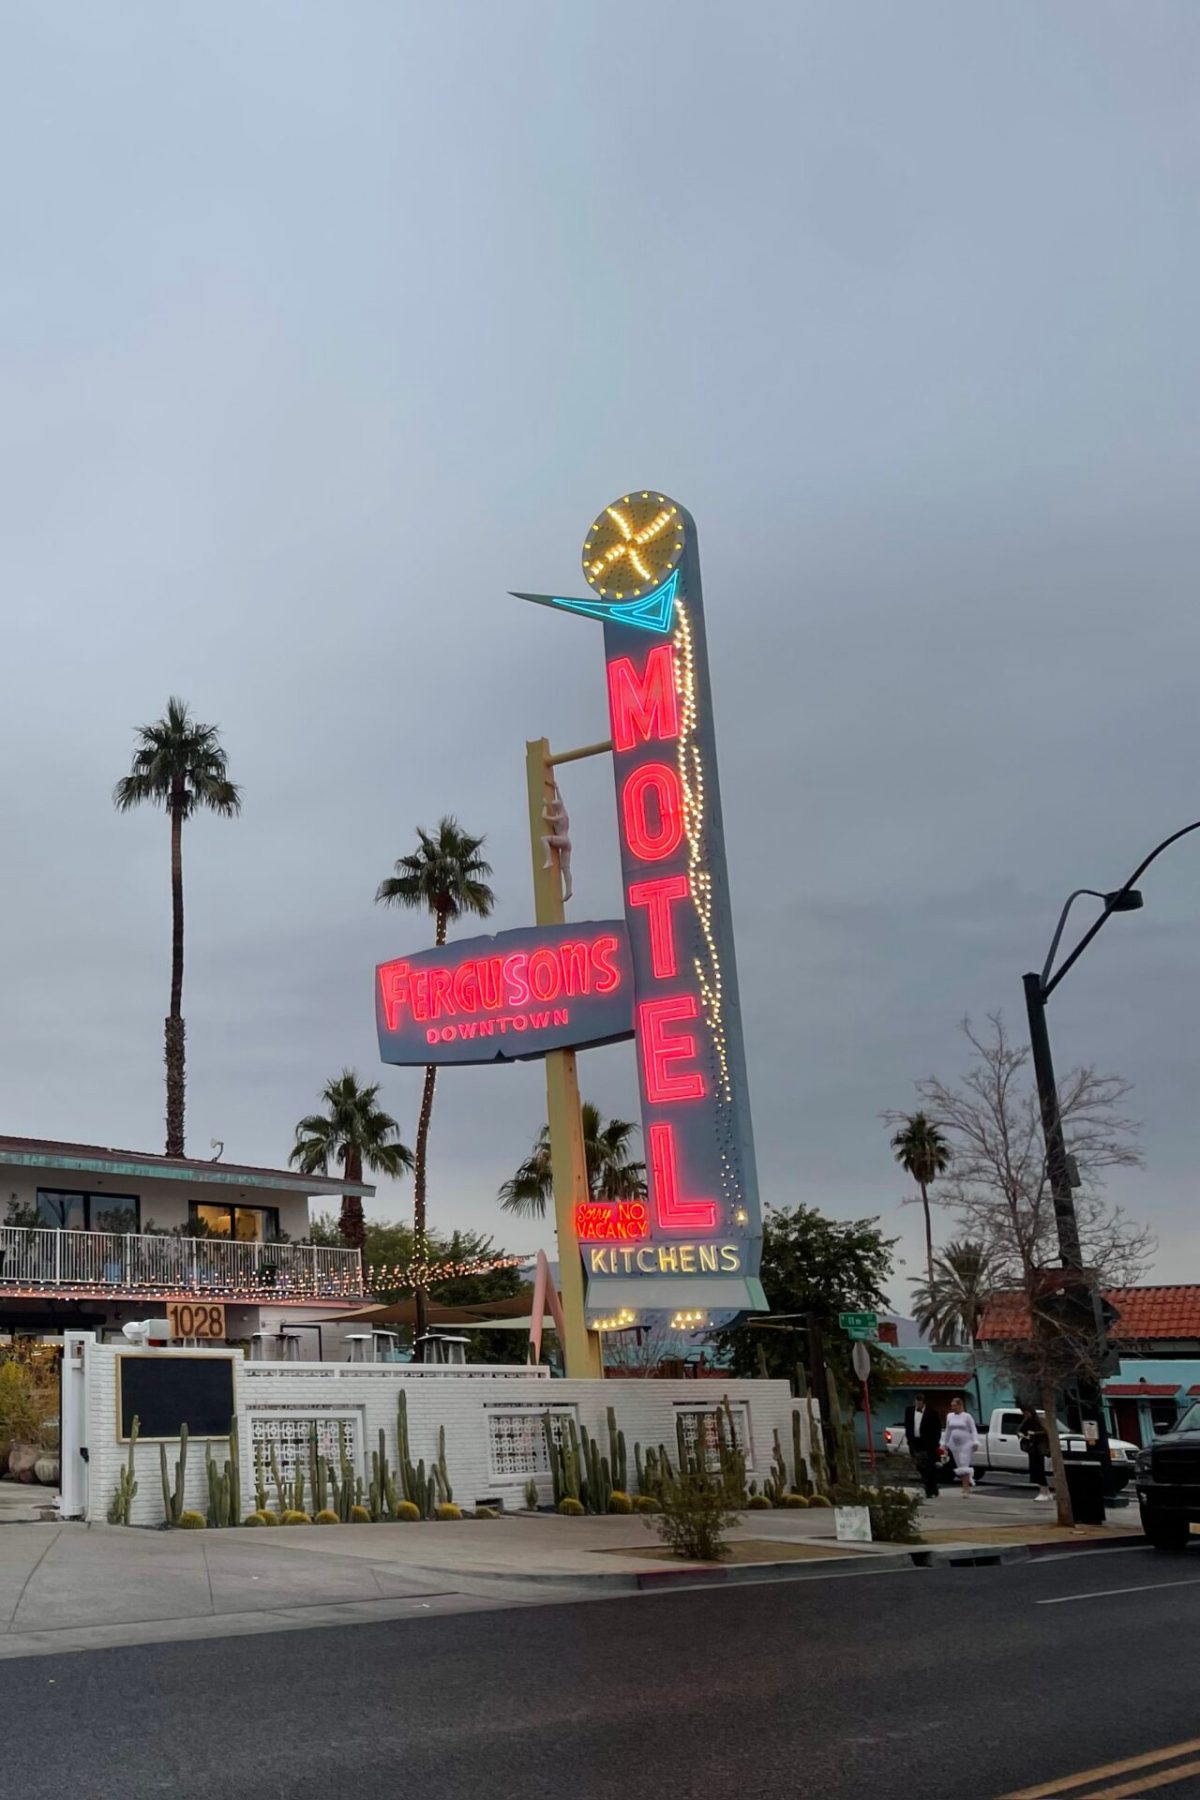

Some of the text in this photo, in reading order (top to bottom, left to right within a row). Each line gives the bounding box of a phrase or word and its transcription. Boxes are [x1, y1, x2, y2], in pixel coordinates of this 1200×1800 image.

[608, 644, 716, 1230] MOTEL
[426, 1008, 569, 1044] DOWNTOWN
[578, 1203, 645, 1223] Sorry NO
[577, 1220, 648, 1239] VACANCY
[591, 1244, 741, 1274] KITCHENS
[170, 1305, 223, 1337] 1028
